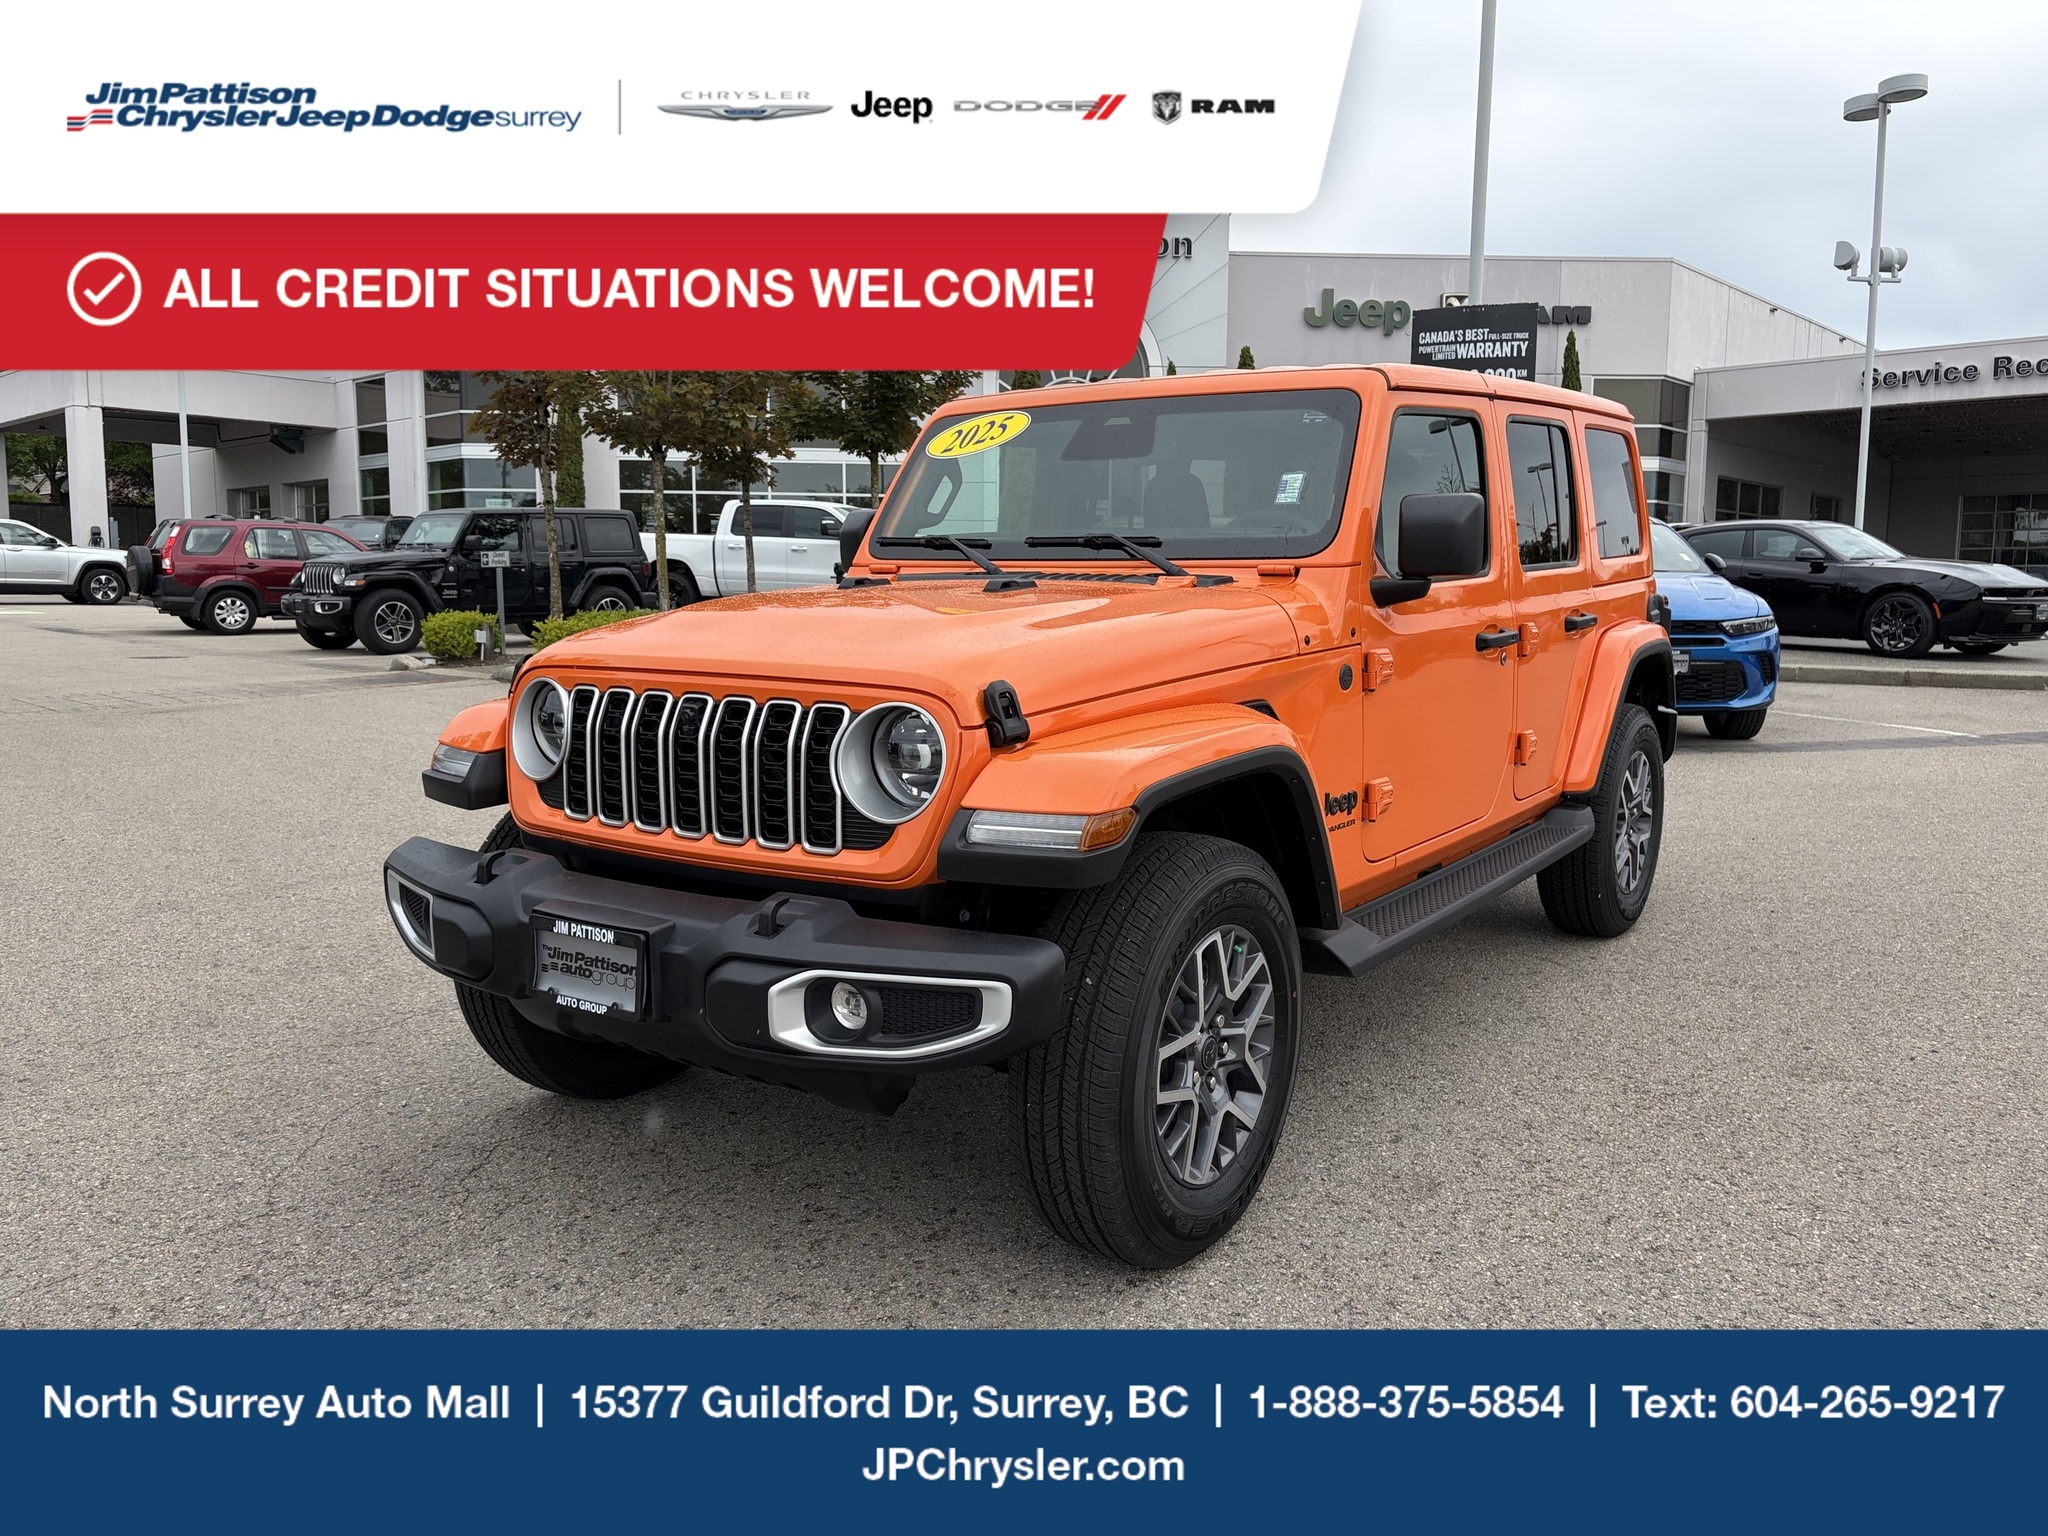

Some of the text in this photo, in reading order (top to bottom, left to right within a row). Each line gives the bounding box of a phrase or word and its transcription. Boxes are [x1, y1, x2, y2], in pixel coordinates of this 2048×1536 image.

[1303, 288, 1411, 336] Jeep
[1418, 330, 1464, 345] CANADA'S
[1465, 328, 1490, 342] BEST
[1489, 332, 1513, 340] FULL-SIZE
[1418, 344, 1456, 354] POWERTRAIN
[1432, 351, 1456, 361] LIMITED
[1456, 341, 1529, 360] WARRANTY
[1861, 356, 2048, 390] Service Rec
[940, 415, 1015, 454] 2025
[441, 588, 458, 596] Jeep
[1328, 818, 1356, 832] ANGLER
[552, 920, 615, 944] JIM PATTISON
[542, 944, 552, 952] The
[1158, 881, 1288, 1005] BRIDGESTONE
[556, 995, 608, 1016] AUTO GROUP
